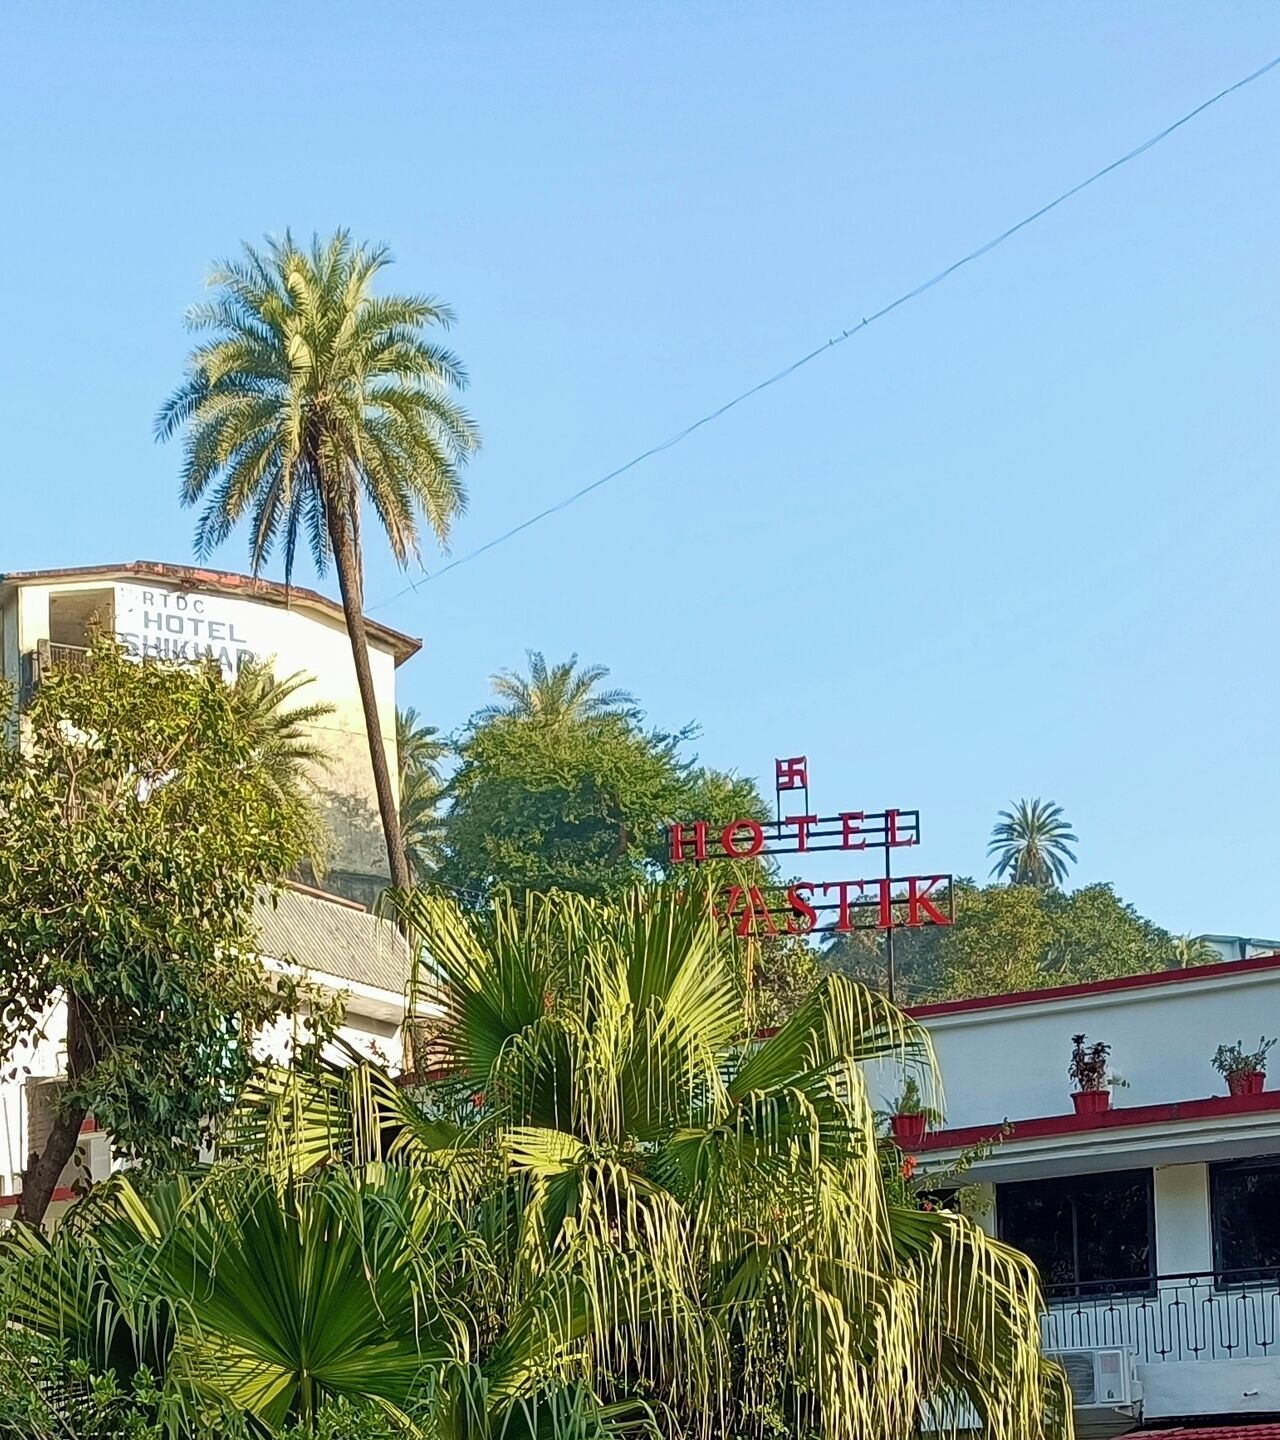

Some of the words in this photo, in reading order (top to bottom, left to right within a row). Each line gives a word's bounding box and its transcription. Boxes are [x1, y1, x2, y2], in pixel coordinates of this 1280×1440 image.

[143, 591, 204, 613] RTDC
[144, 611, 247, 643] HOTEL
[670, 809, 914, 862] HOTEL
